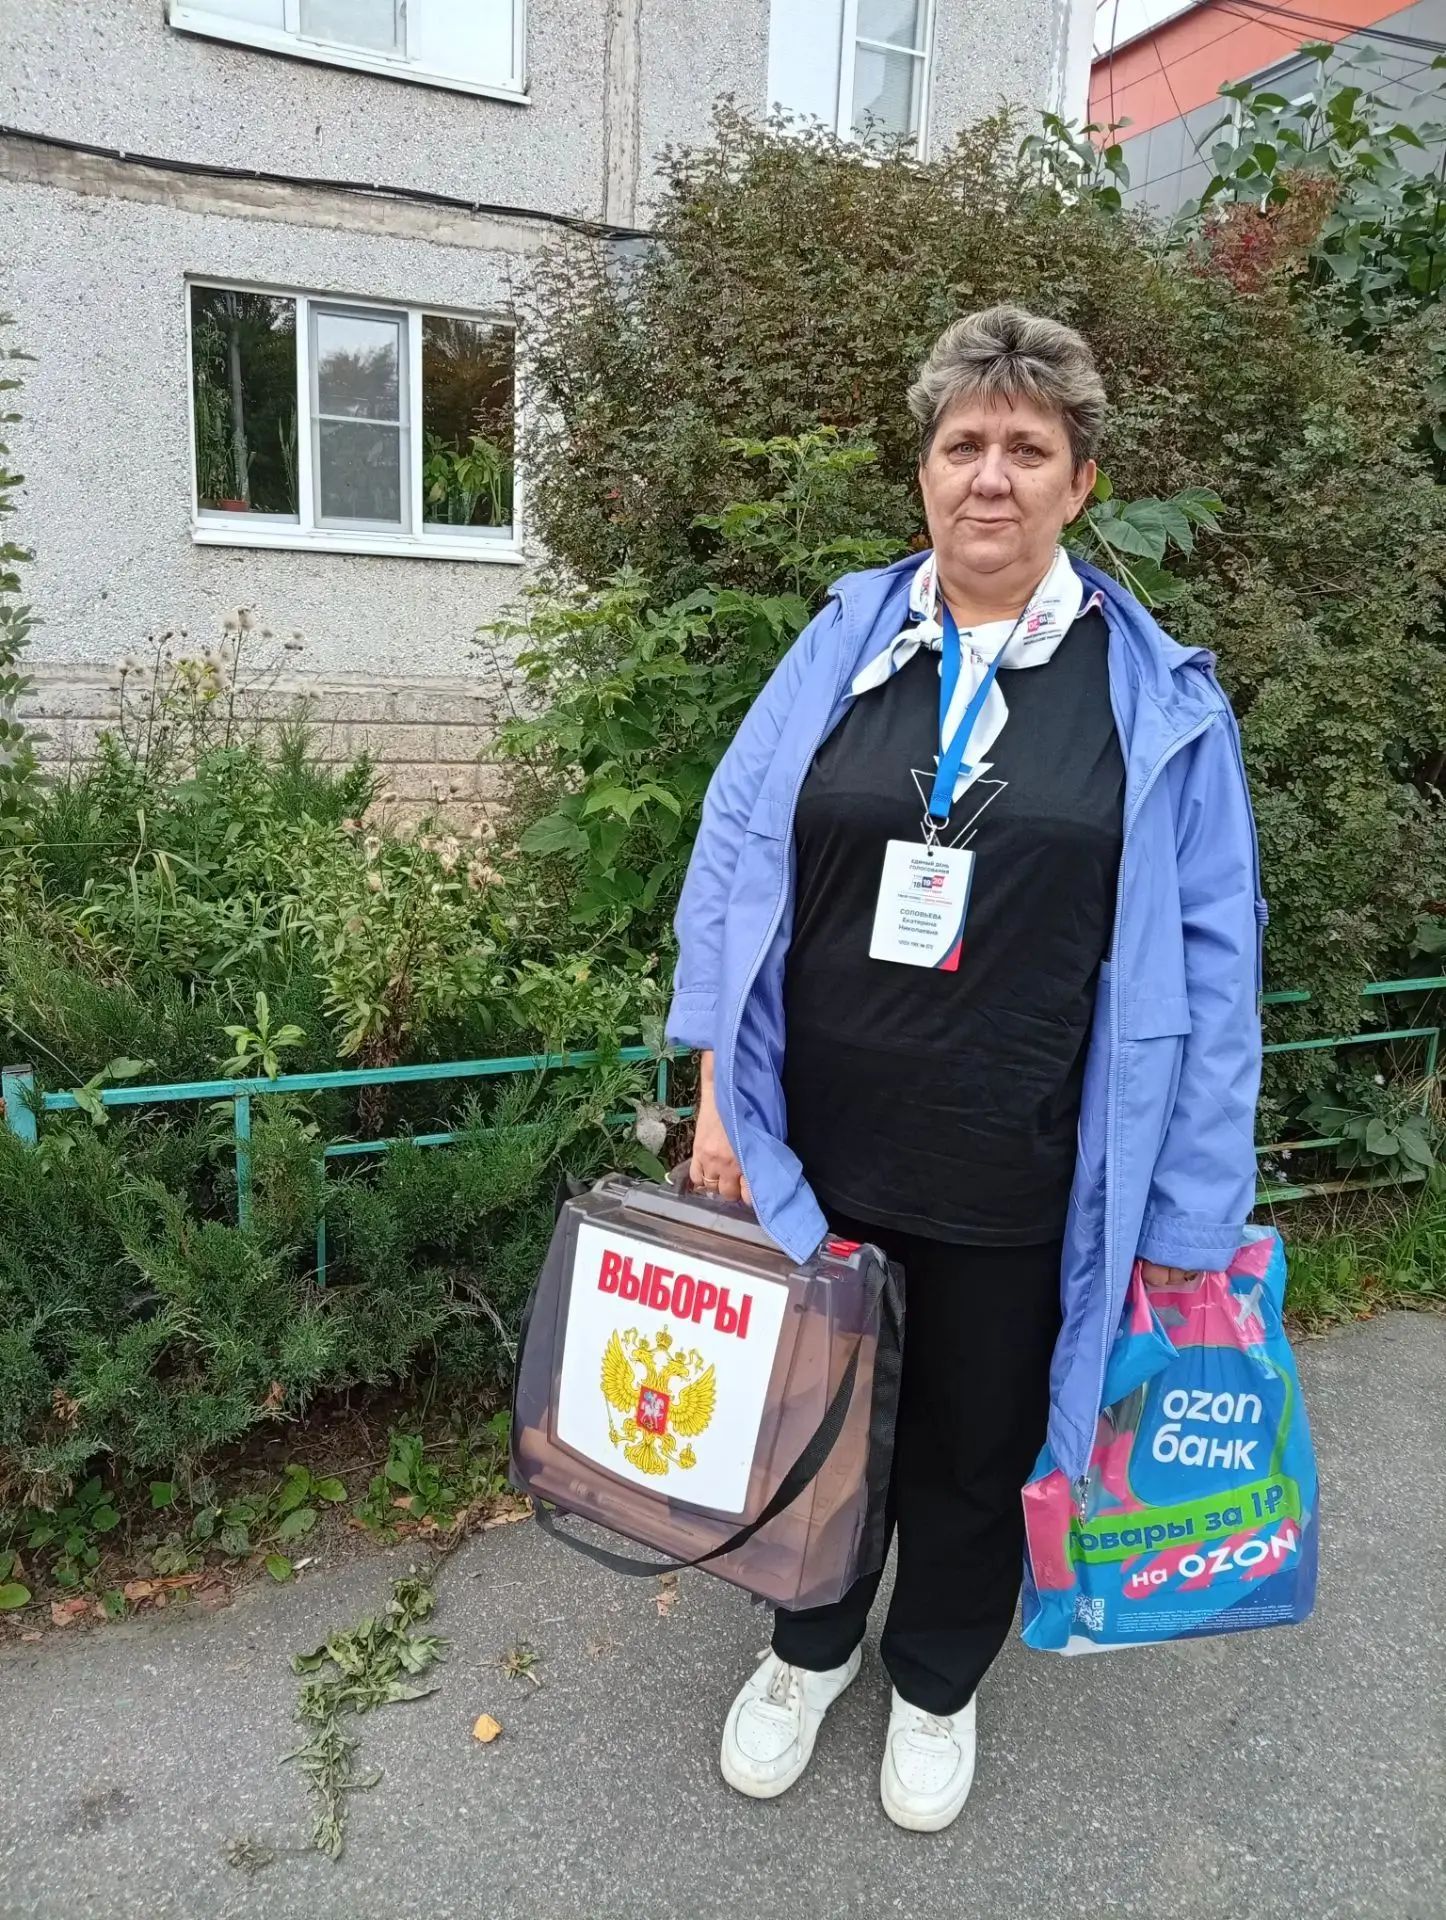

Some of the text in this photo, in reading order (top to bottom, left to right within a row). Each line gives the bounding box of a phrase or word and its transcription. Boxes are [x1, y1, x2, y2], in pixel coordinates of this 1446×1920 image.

[900, 908, 942, 920] СОЛОВЬЕВА
[902, 917, 937, 928] Екатерина
[898, 924, 938, 935] Николаевна
[598, 1249, 753, 1339] ВЫБОРЫ
[1162, 1389, 1262, 1424] ozon
[1152, 1423, 1258, 1470] банк
[1204, 1506, 1243, 1531] за
[1131, 1528, 1298, 1588] на OZON
